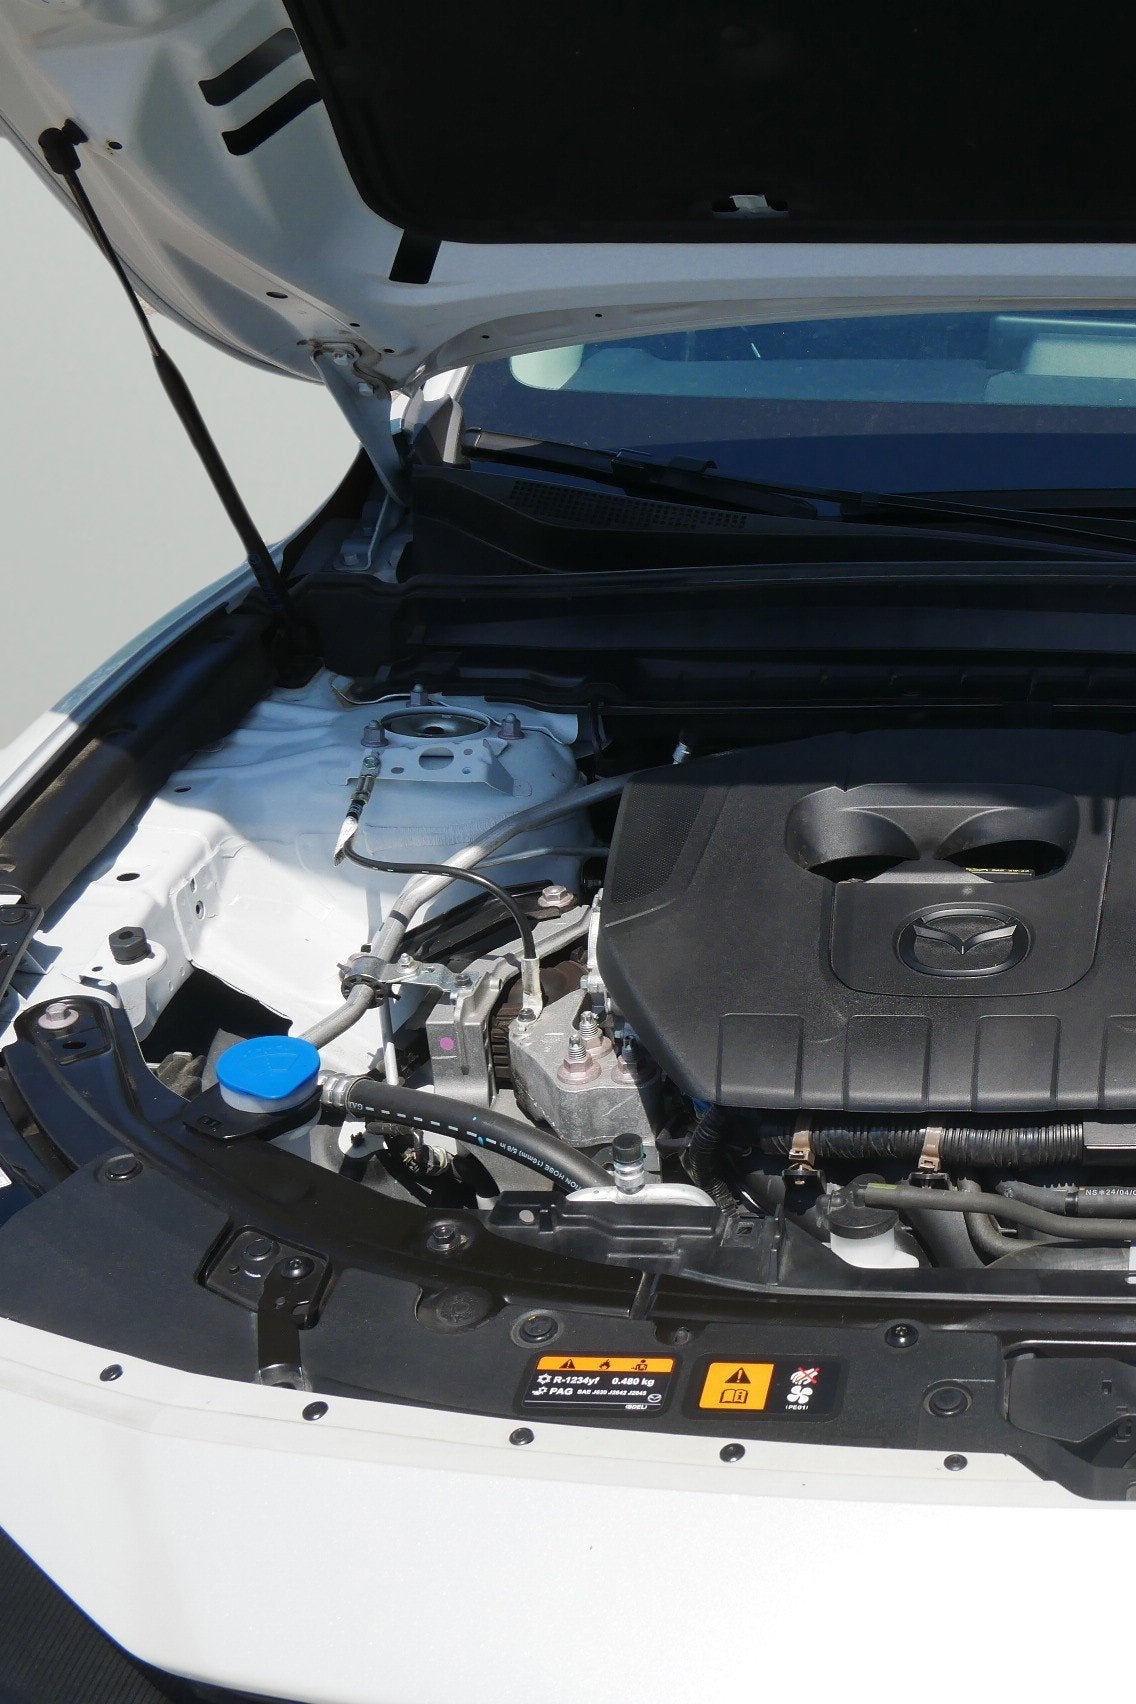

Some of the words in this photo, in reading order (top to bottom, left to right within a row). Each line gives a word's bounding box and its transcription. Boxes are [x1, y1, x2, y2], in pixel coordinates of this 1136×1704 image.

[544, 1164, 565, 1179] HOSE
[553, 1376, 600, 1385] R-1234yf
[611, 1377, 640, 1385] 0.480
[641, 1378, 655, 1387] kg
[549, 1387, 574, 1396] PAG
